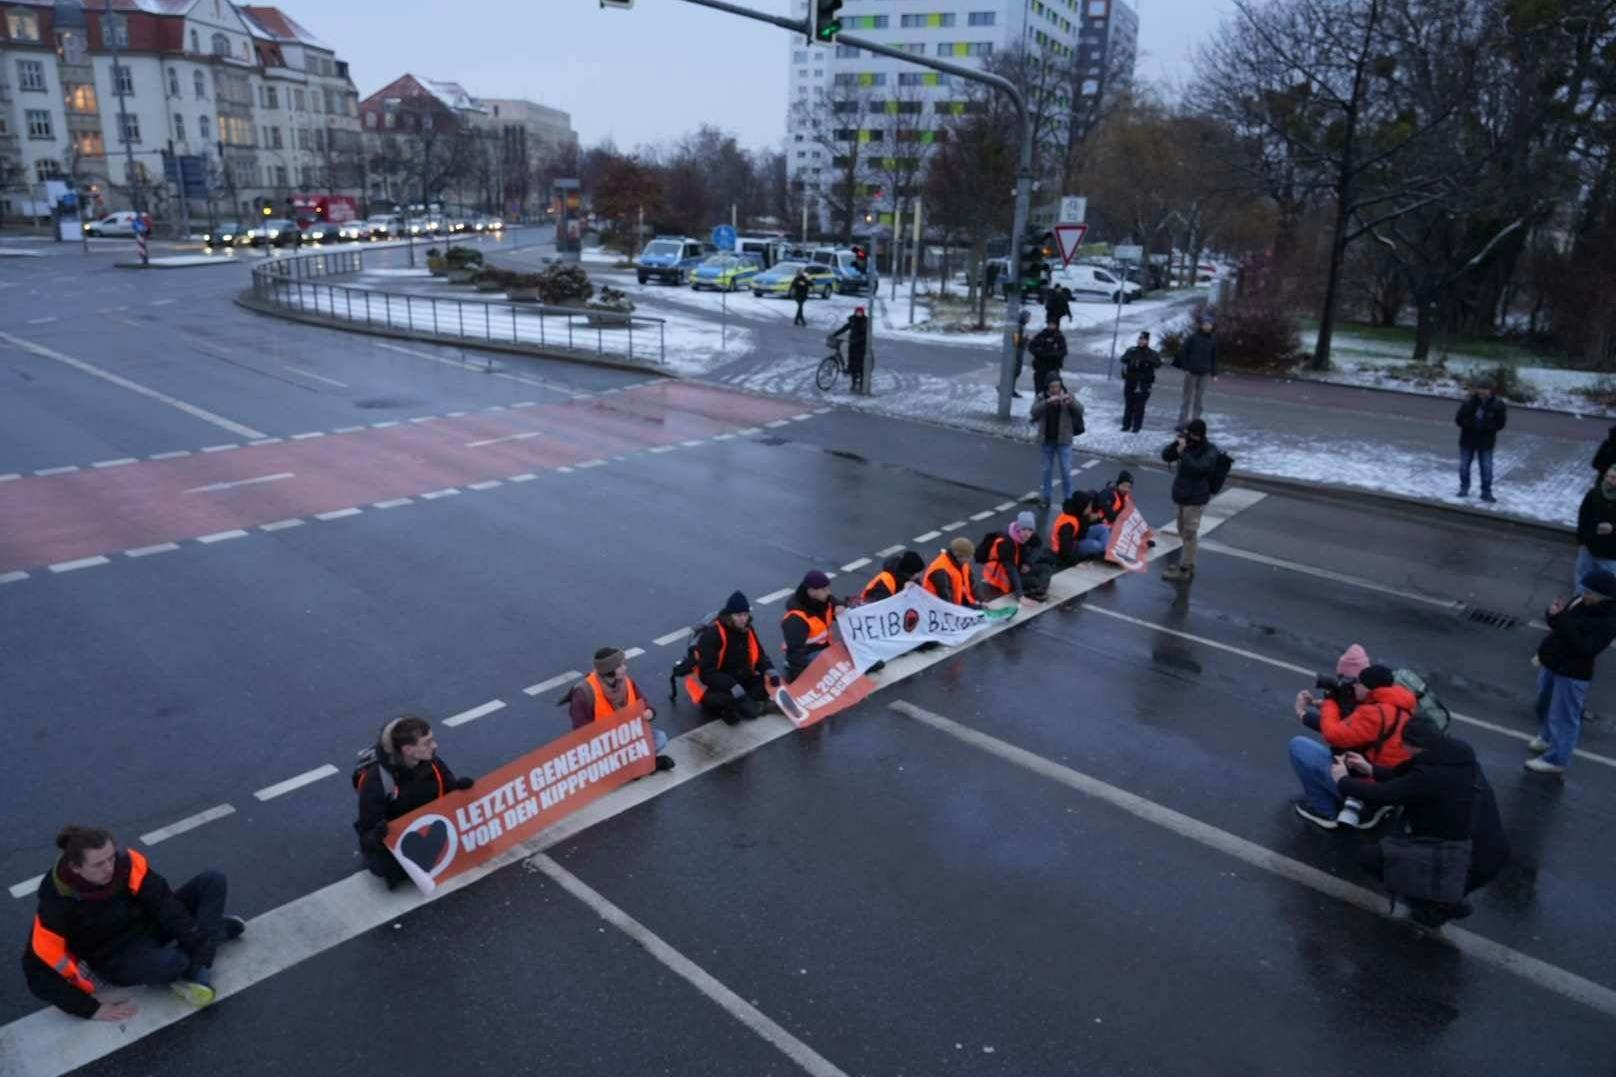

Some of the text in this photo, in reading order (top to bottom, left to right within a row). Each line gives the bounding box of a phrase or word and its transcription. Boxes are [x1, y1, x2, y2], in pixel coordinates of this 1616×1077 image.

[455, 716, 644, 831] LETZTE GENERATION
[459, 738, 650, 853] VOR DEN KIPPPUNKTEN
